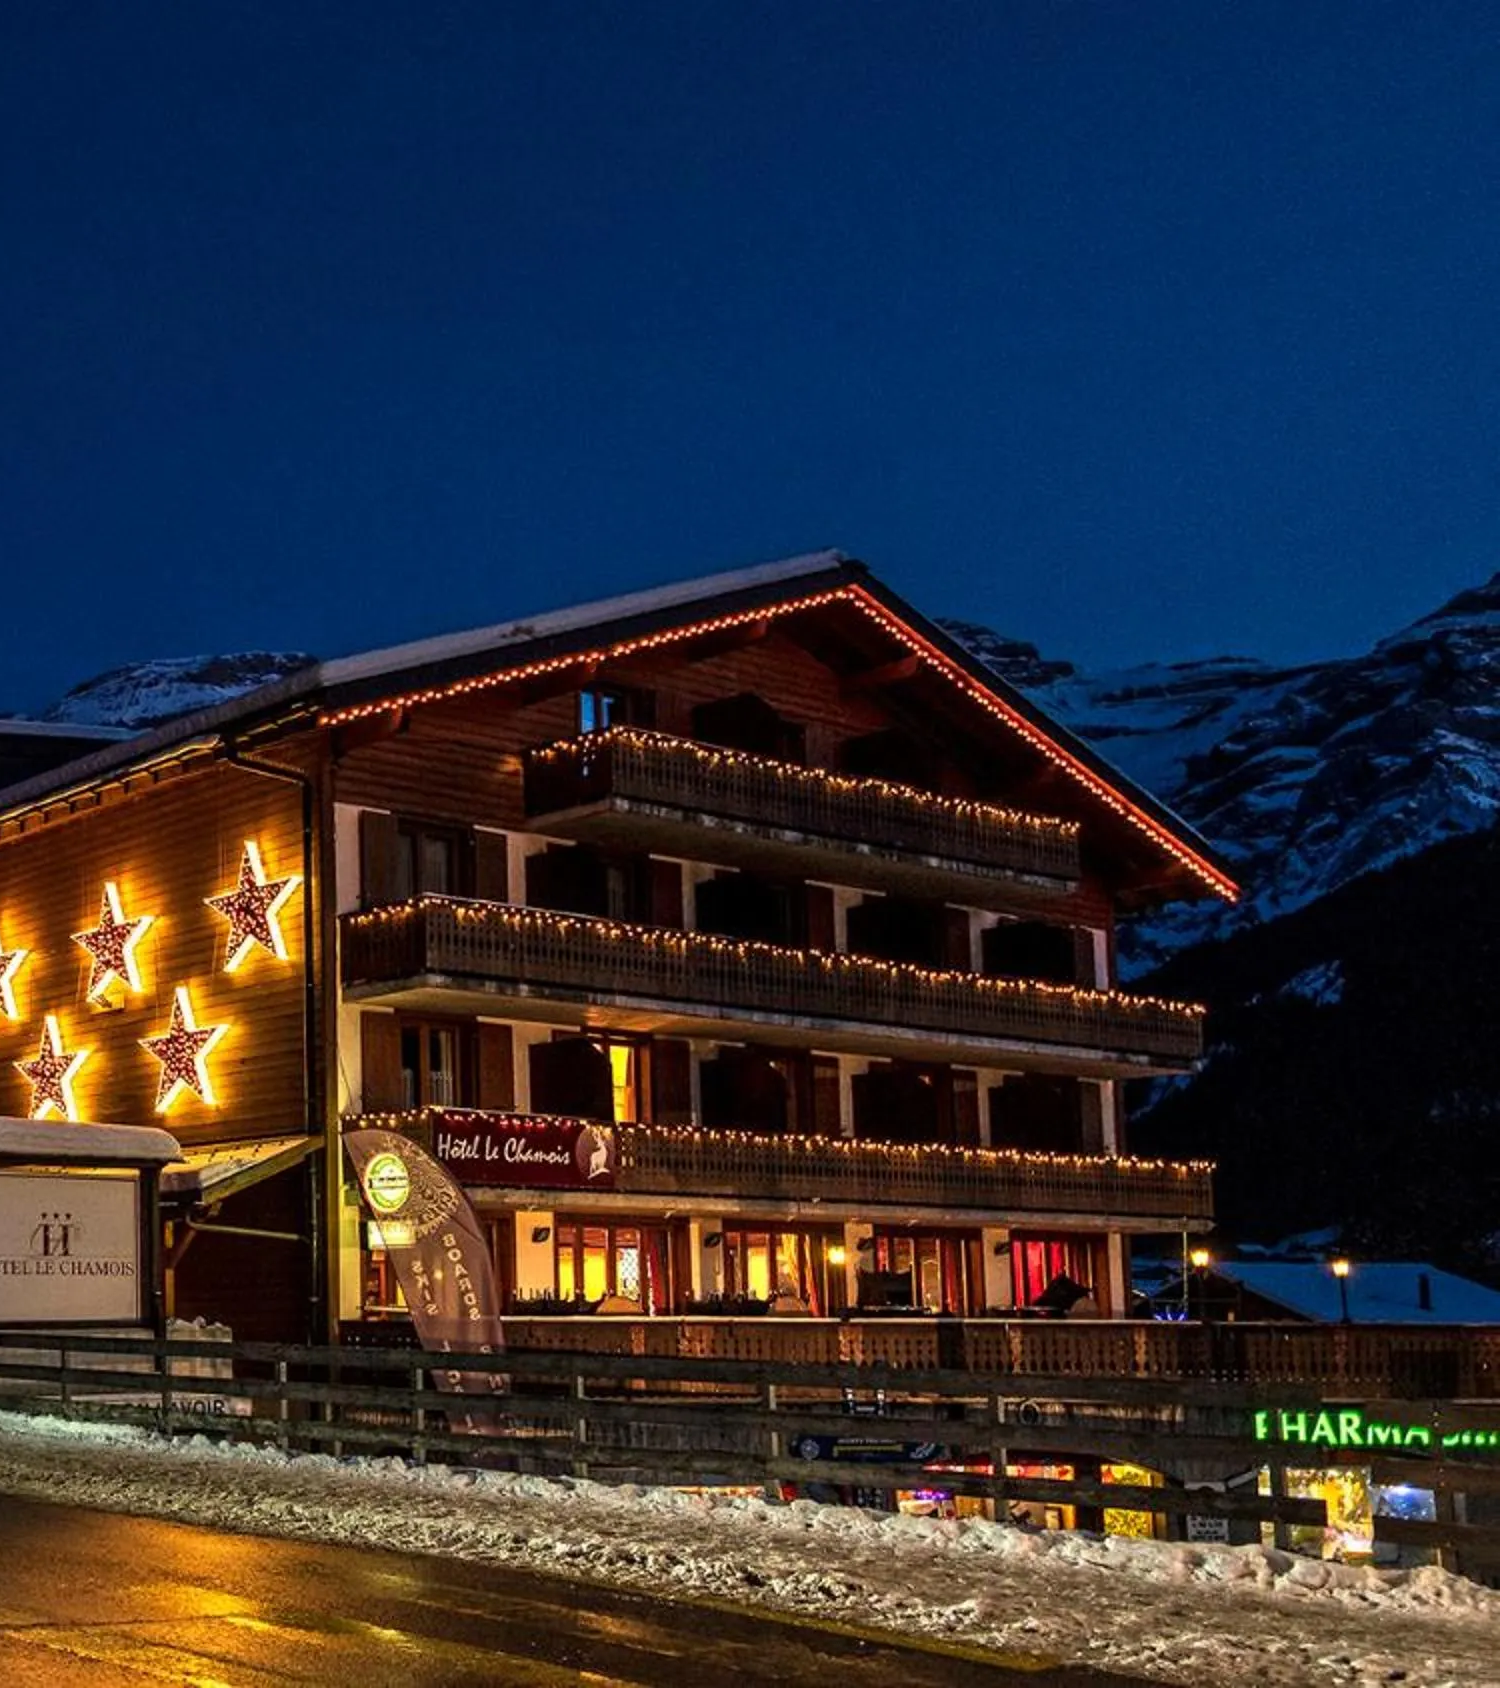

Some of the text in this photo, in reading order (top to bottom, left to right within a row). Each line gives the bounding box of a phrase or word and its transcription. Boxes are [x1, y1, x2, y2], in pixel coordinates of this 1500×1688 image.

[503, 1137, 571, 1165] Chamois
[35, 1260, 56, 1276] LE
[59, 1260, 135, 1277] CHAMOIS
[1255, 1409, 1499, 1447] PHARMA
